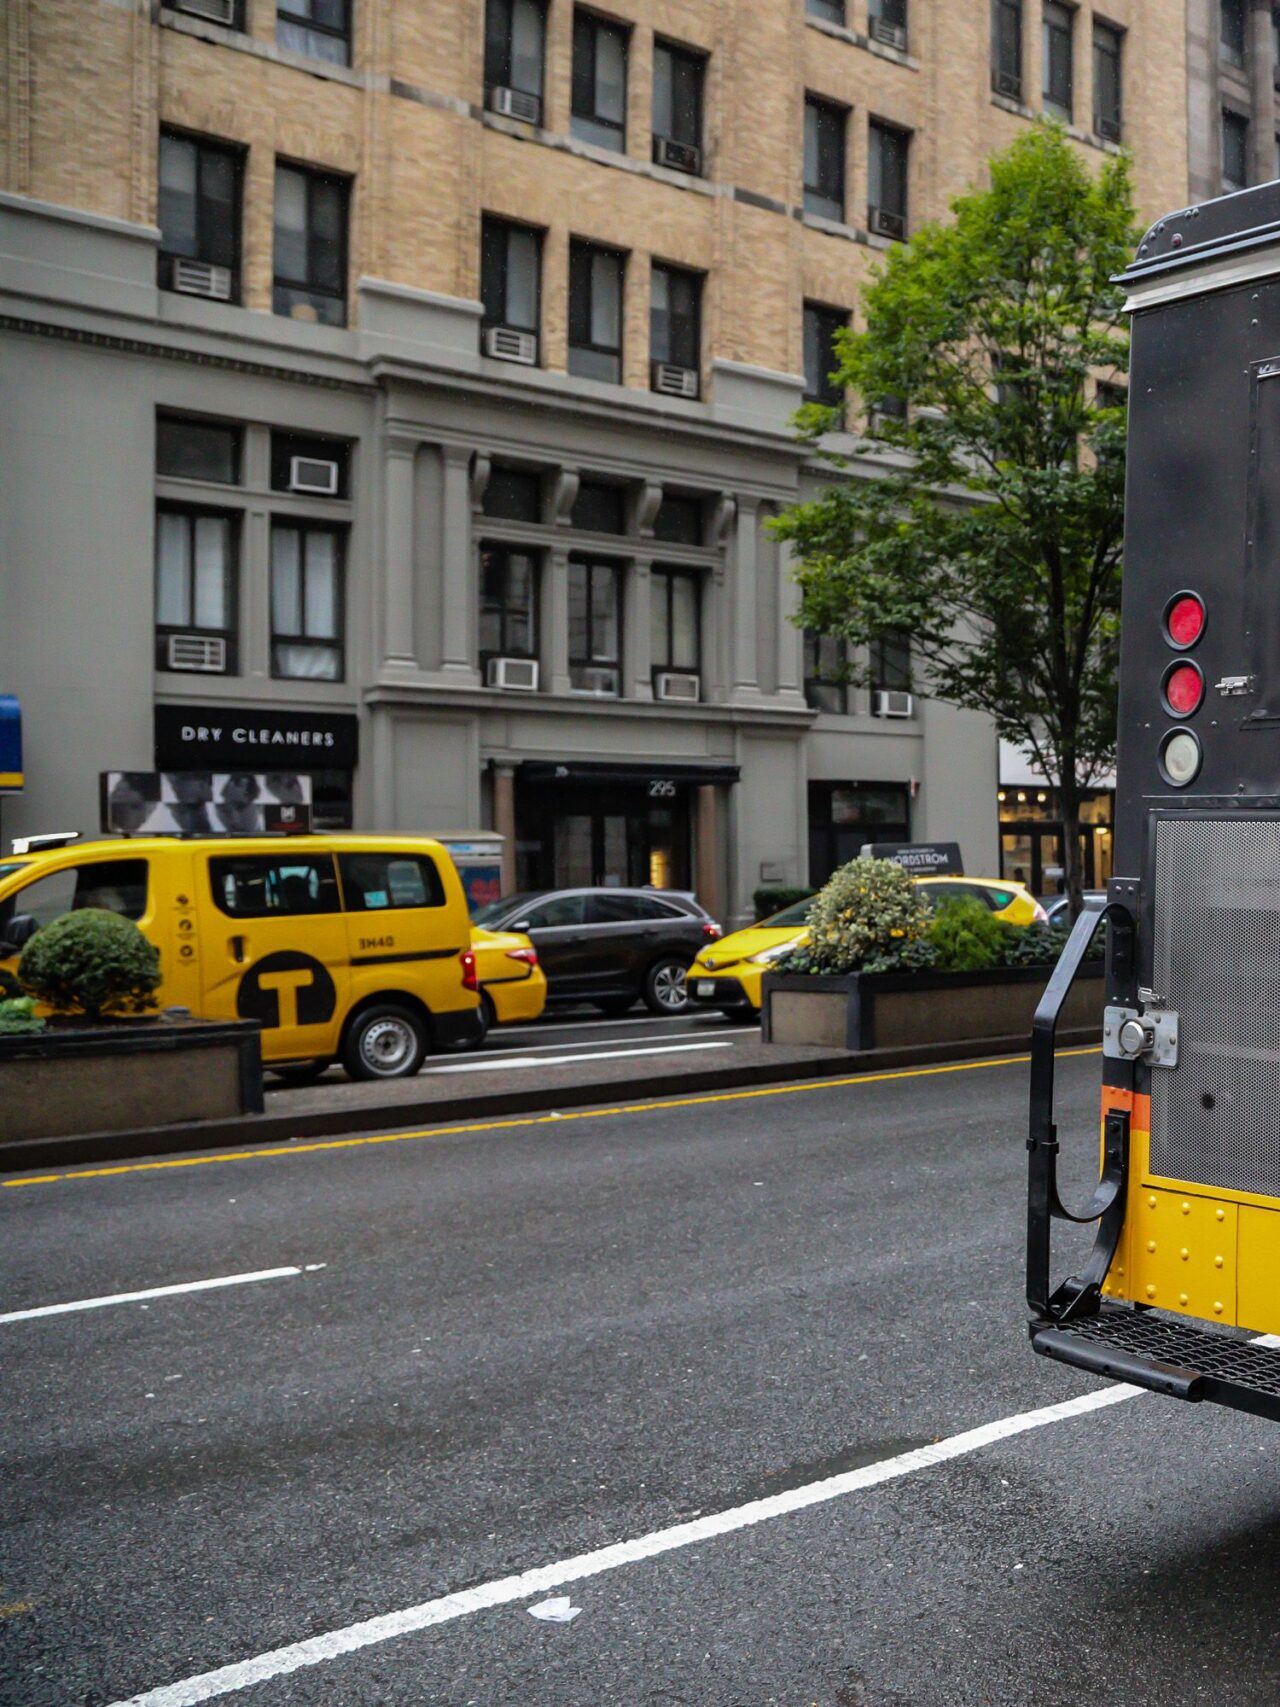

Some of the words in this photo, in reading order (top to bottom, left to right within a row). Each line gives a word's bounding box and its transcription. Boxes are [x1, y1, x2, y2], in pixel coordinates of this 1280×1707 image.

[181, 726, 222, 741] DRY
[232, 728, 334, 747] CLEANERS
[649, 780, 676, 796] 295
